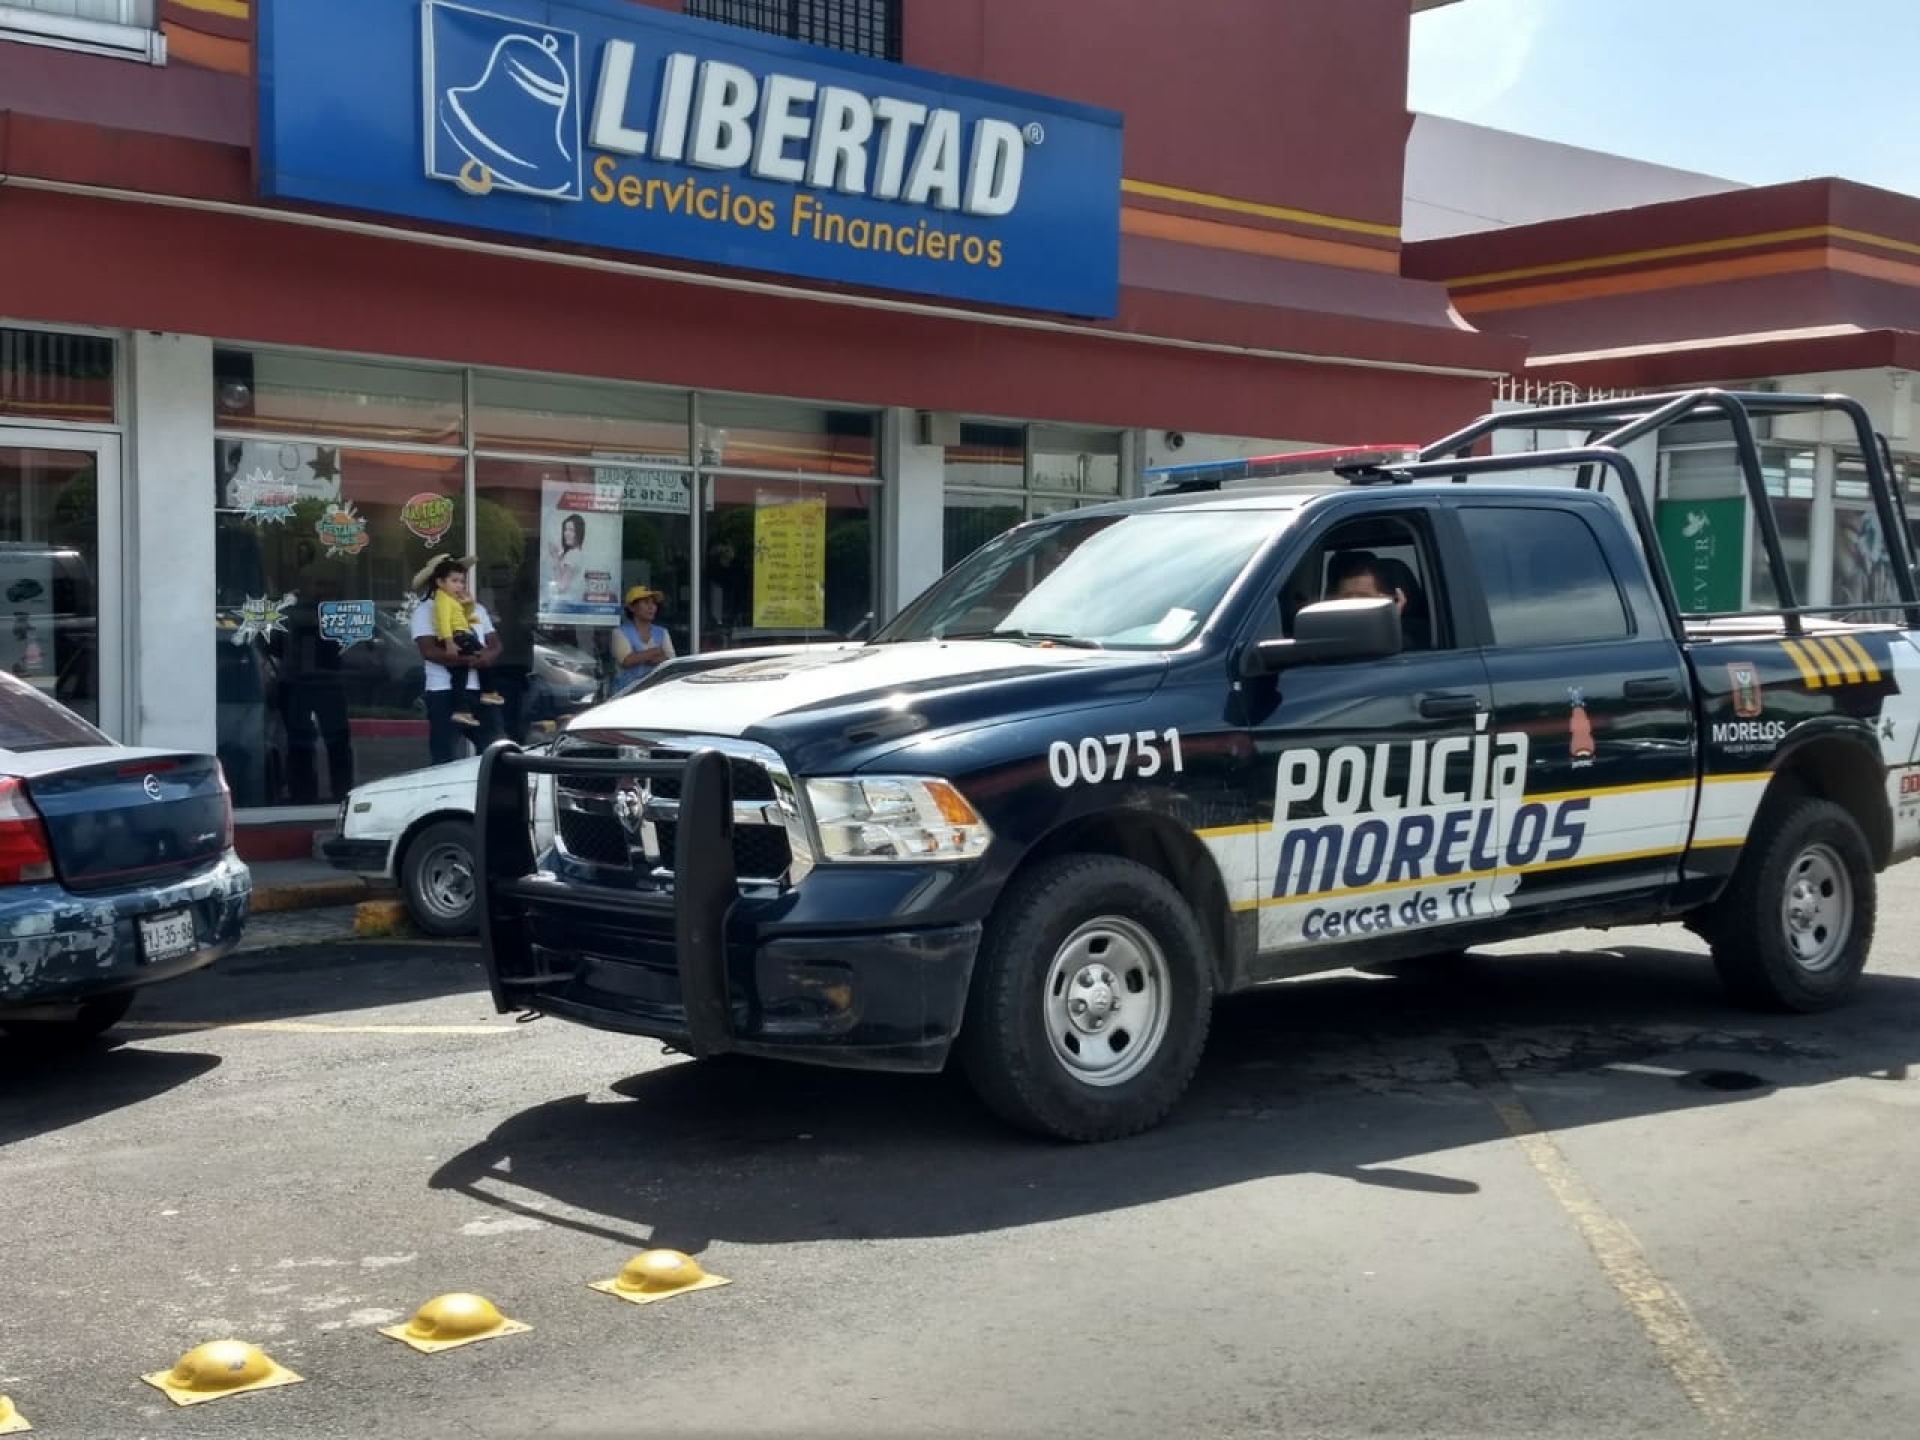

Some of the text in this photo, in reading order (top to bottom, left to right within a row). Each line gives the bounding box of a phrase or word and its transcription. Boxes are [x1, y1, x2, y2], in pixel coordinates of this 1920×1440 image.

[588, 38, 1026, 217] LIBERTAD
[589, 155, 1004, 269] Servicios Financieros
[1049, 726, 1183, 789] 00751
[1712, 720, 1786, 743] MORELOS
[1272, 797, 1591, 899] MORELOS
[1301, 901, 1392, 941] Cerca
[1398, 891, 1439, 926] de
